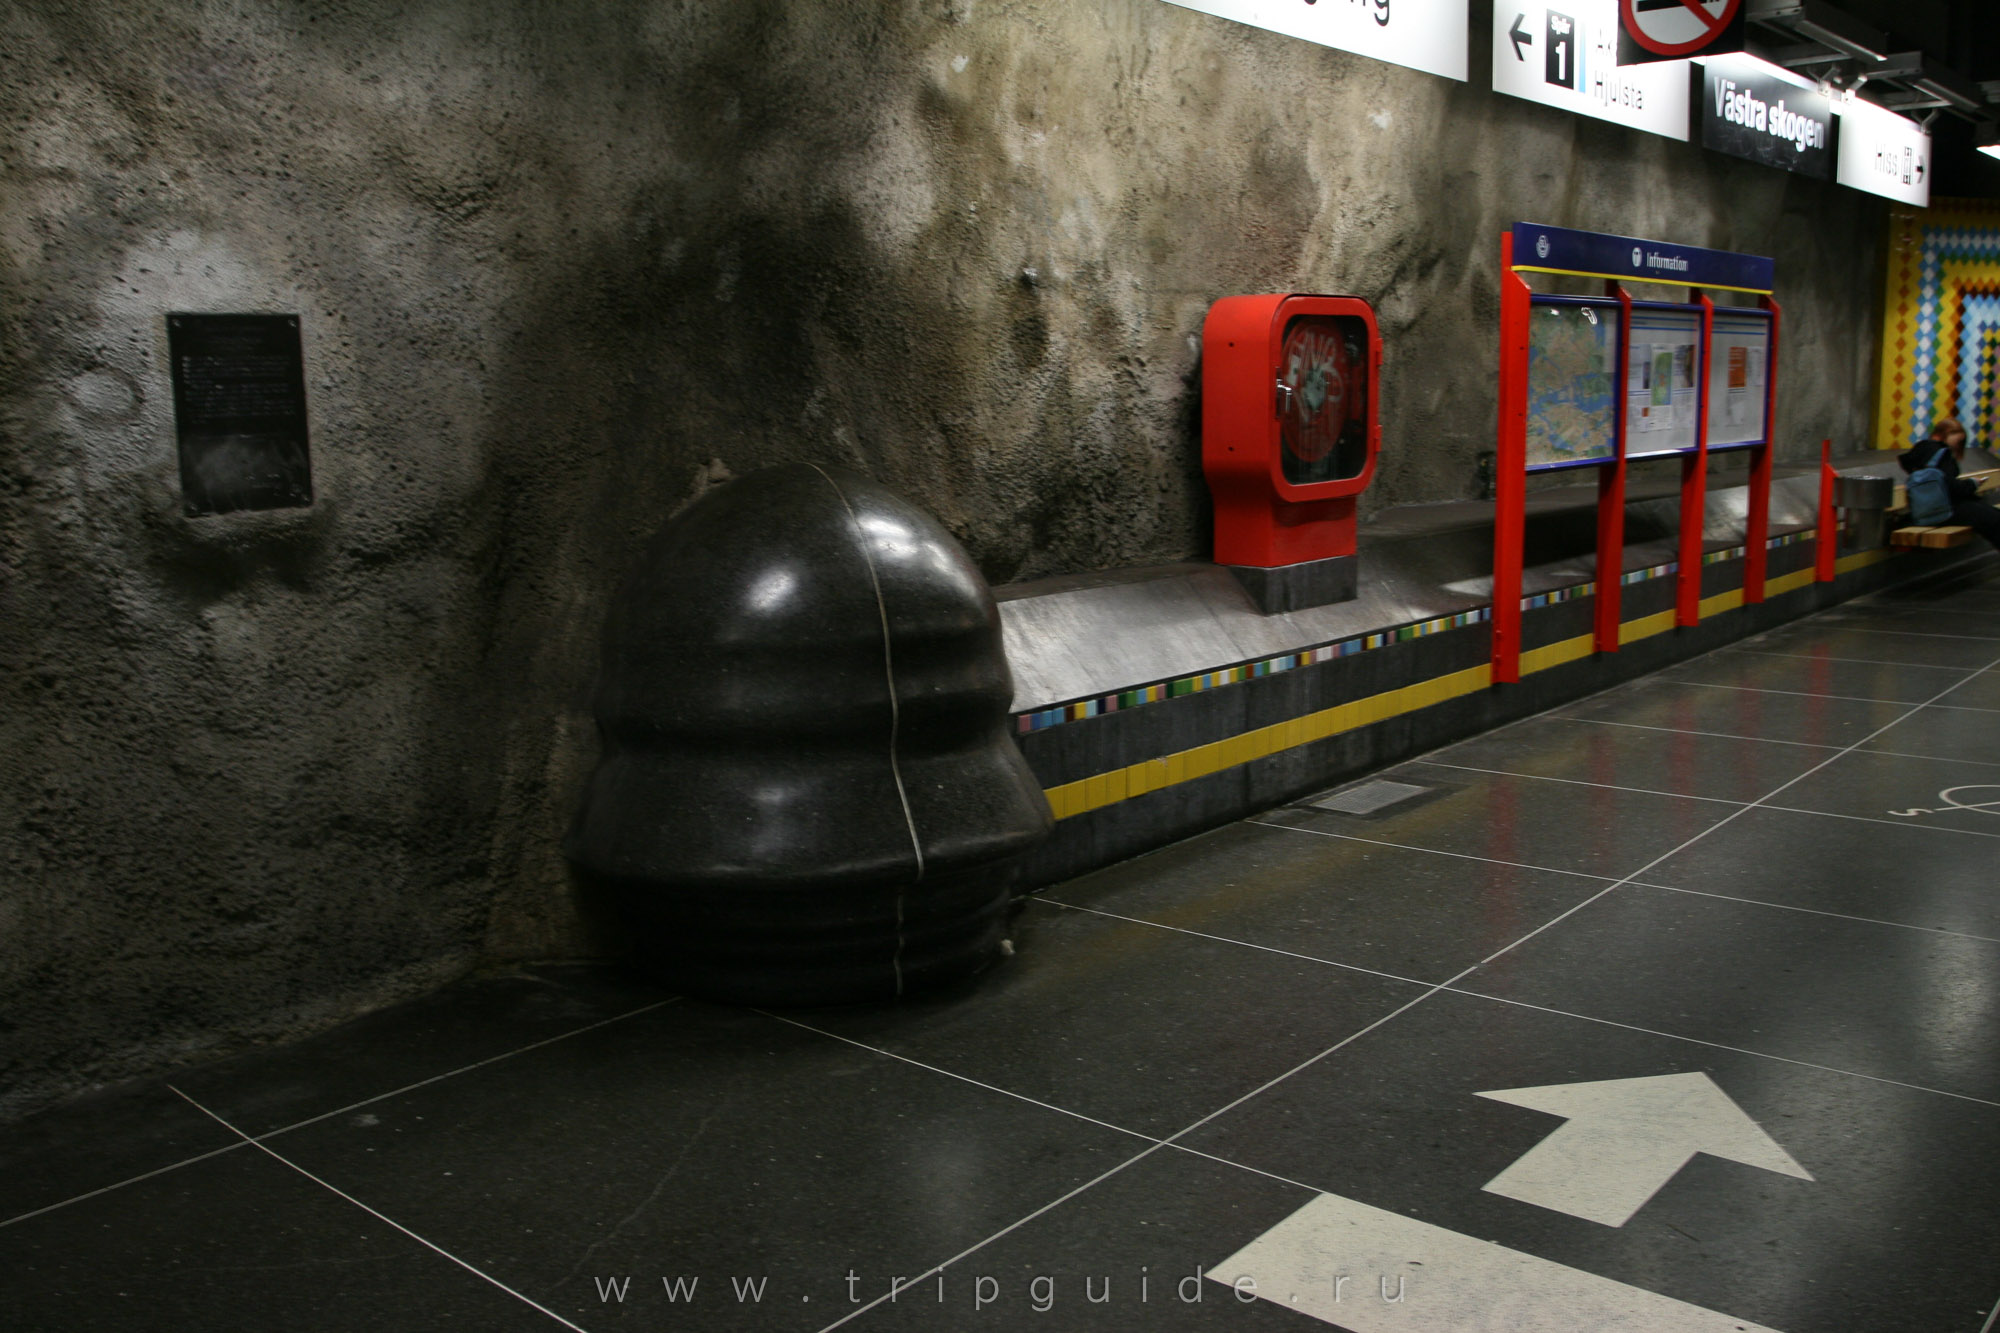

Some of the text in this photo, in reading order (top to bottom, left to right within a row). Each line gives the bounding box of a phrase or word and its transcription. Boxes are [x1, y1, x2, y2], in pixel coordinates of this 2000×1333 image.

[1555, 41, 1566, 80] 1
[1594, 69, 1644, 110] Hjulsta
[1713, 75, 1824, 153] Västra skogen
[1874, 143, 1898, 177] Hiss
[1646, 252, 1688, 271] Information
